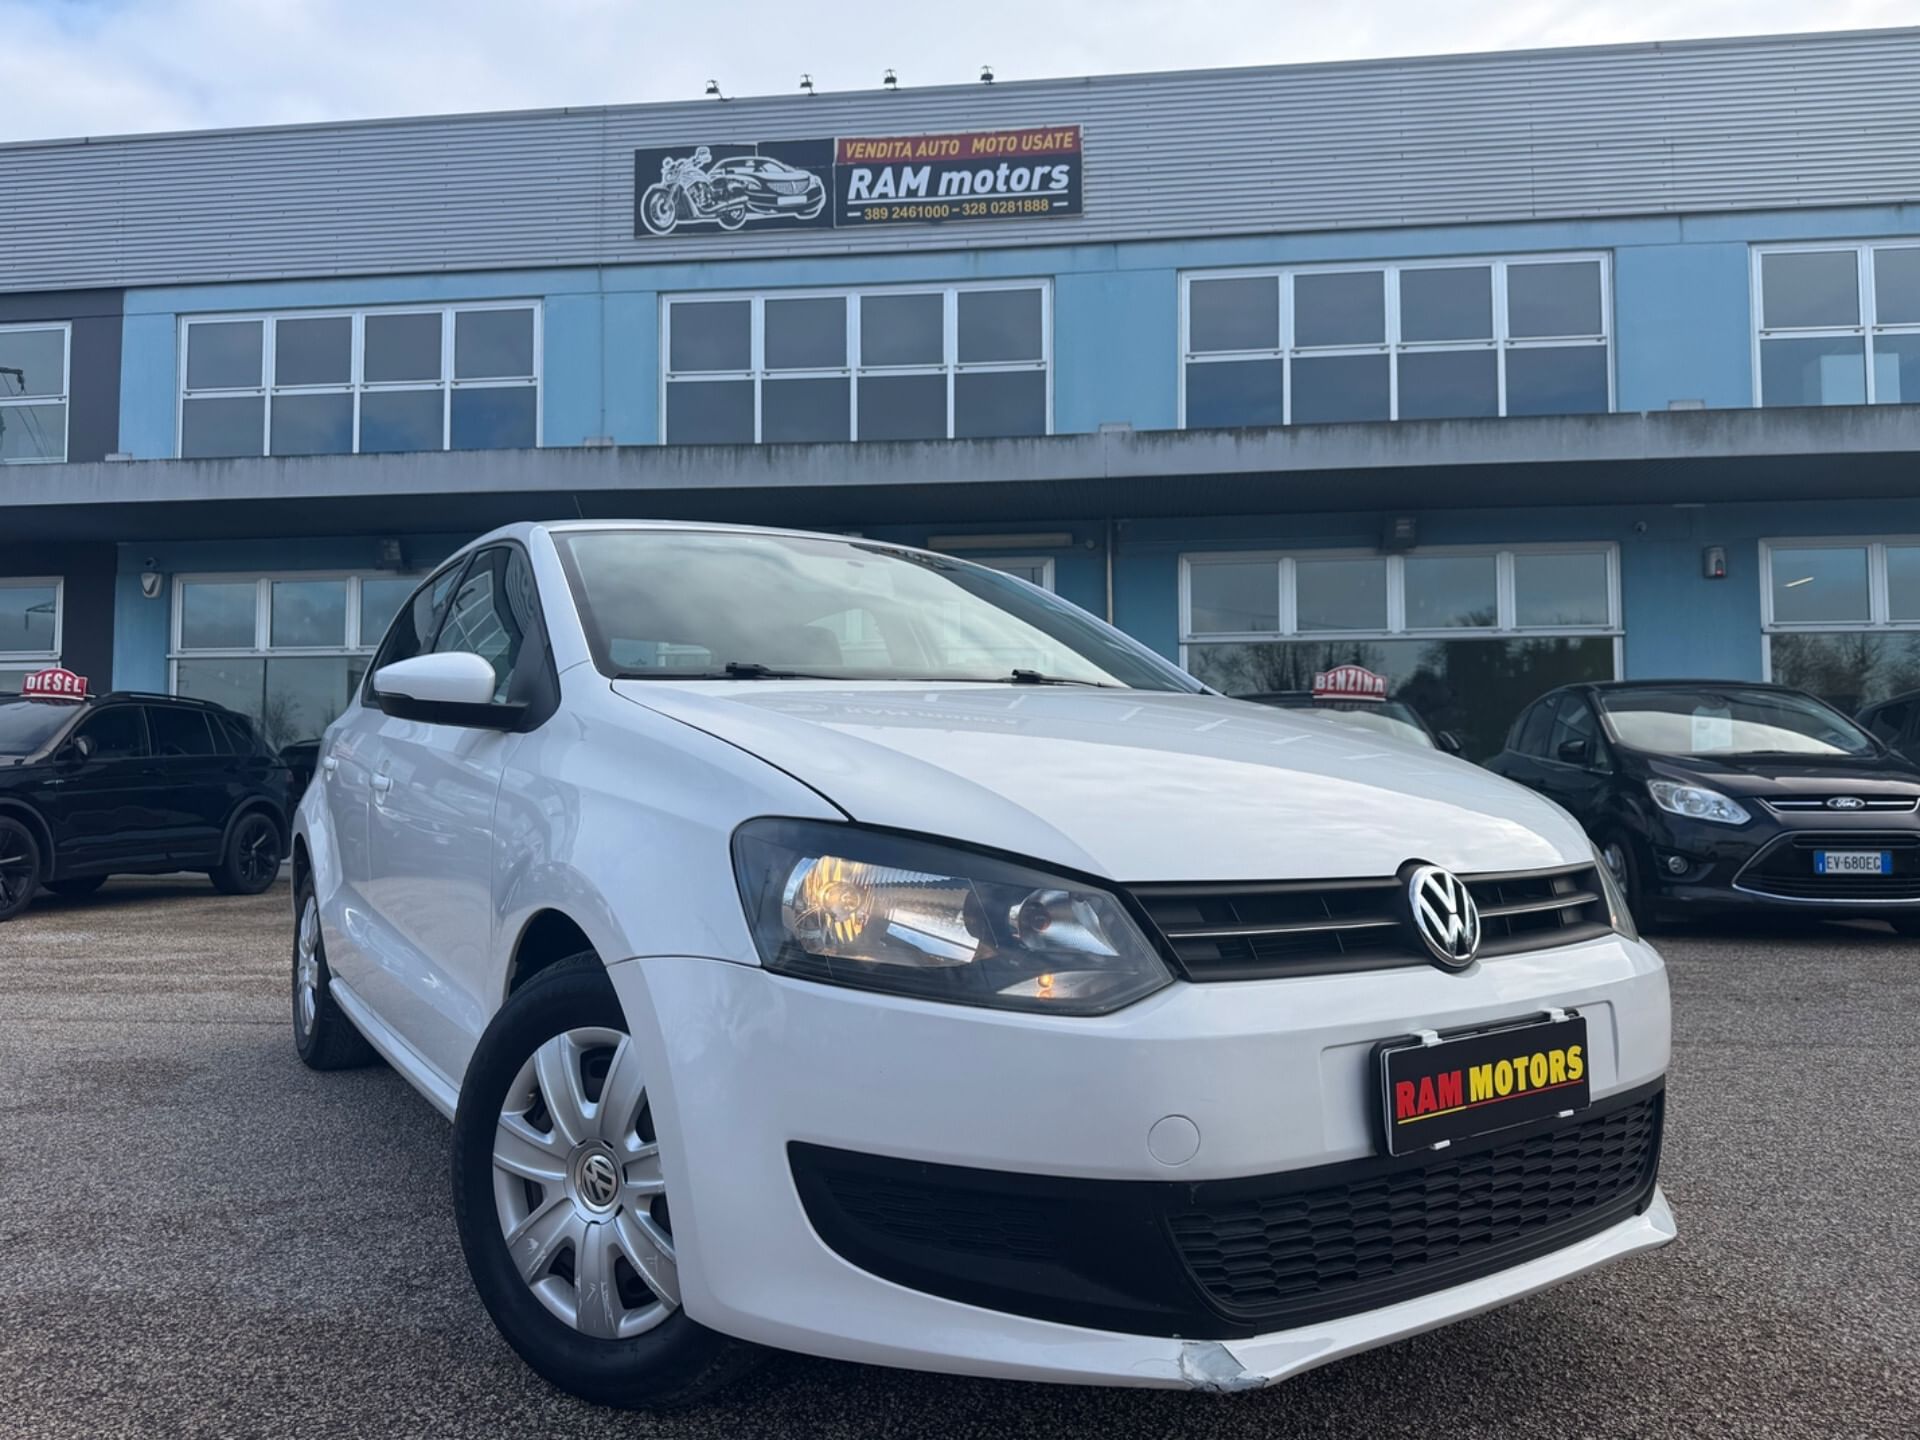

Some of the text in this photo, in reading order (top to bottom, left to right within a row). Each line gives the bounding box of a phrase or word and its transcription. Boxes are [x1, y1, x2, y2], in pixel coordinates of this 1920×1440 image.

[846, 132, 1074, 158] VENDITA AUTO MOTO USATE
[847, 163, 1070, 199] RAM motors
[864, 208, 888, 220] 389
[991, 199, 1049, 214] 0281888
[26, 673, 82, 692] DIESEL
[1315, 669, 1384, 692] BENZINA
[1395, 1044, 1583, 1119] RAM MOTORS
